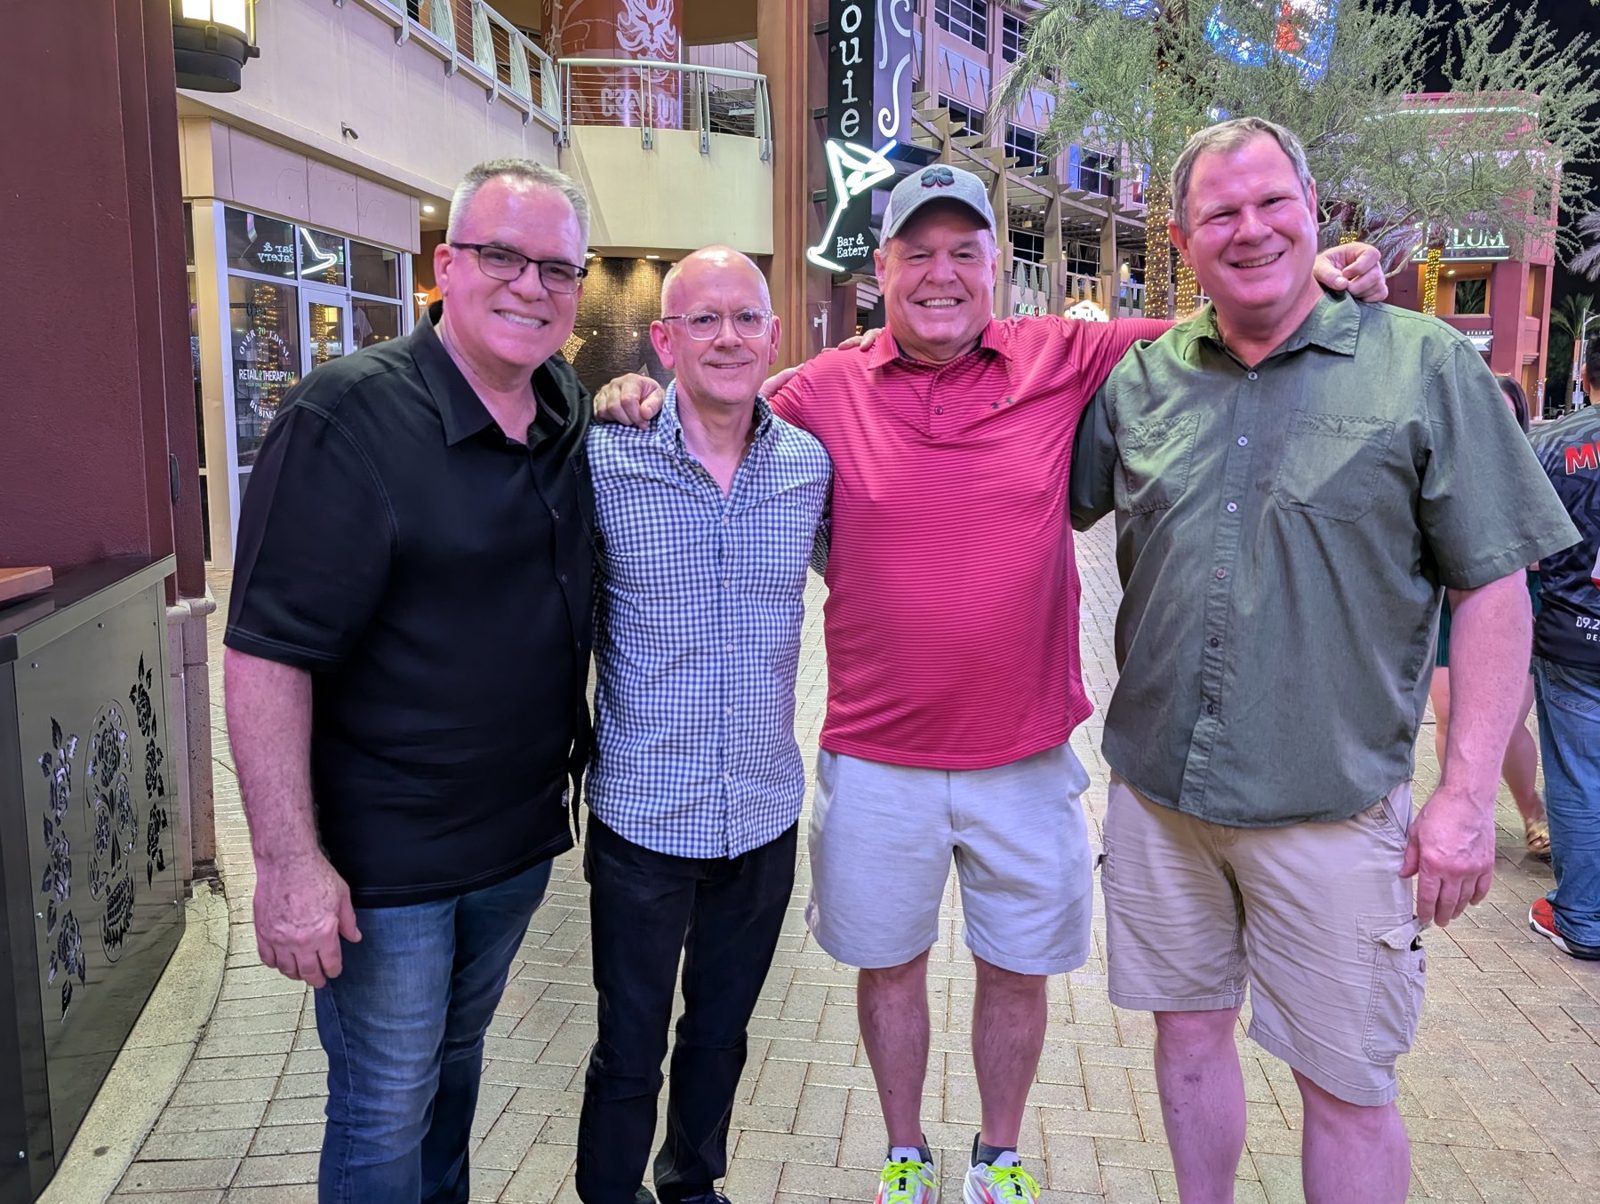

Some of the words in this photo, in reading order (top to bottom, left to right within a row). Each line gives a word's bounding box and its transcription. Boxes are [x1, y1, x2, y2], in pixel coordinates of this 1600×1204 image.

[839, 0, 863, 137] ouie
[836, 236, 855, 247] Bar
[856, 233, 864, 245] &
[836, 245, 870, 258] Eatery
[239, 329, 256, 355] OVER
[268, 330, 290, 360] LOCAL
[1586, 633, 1600, 642] DE
